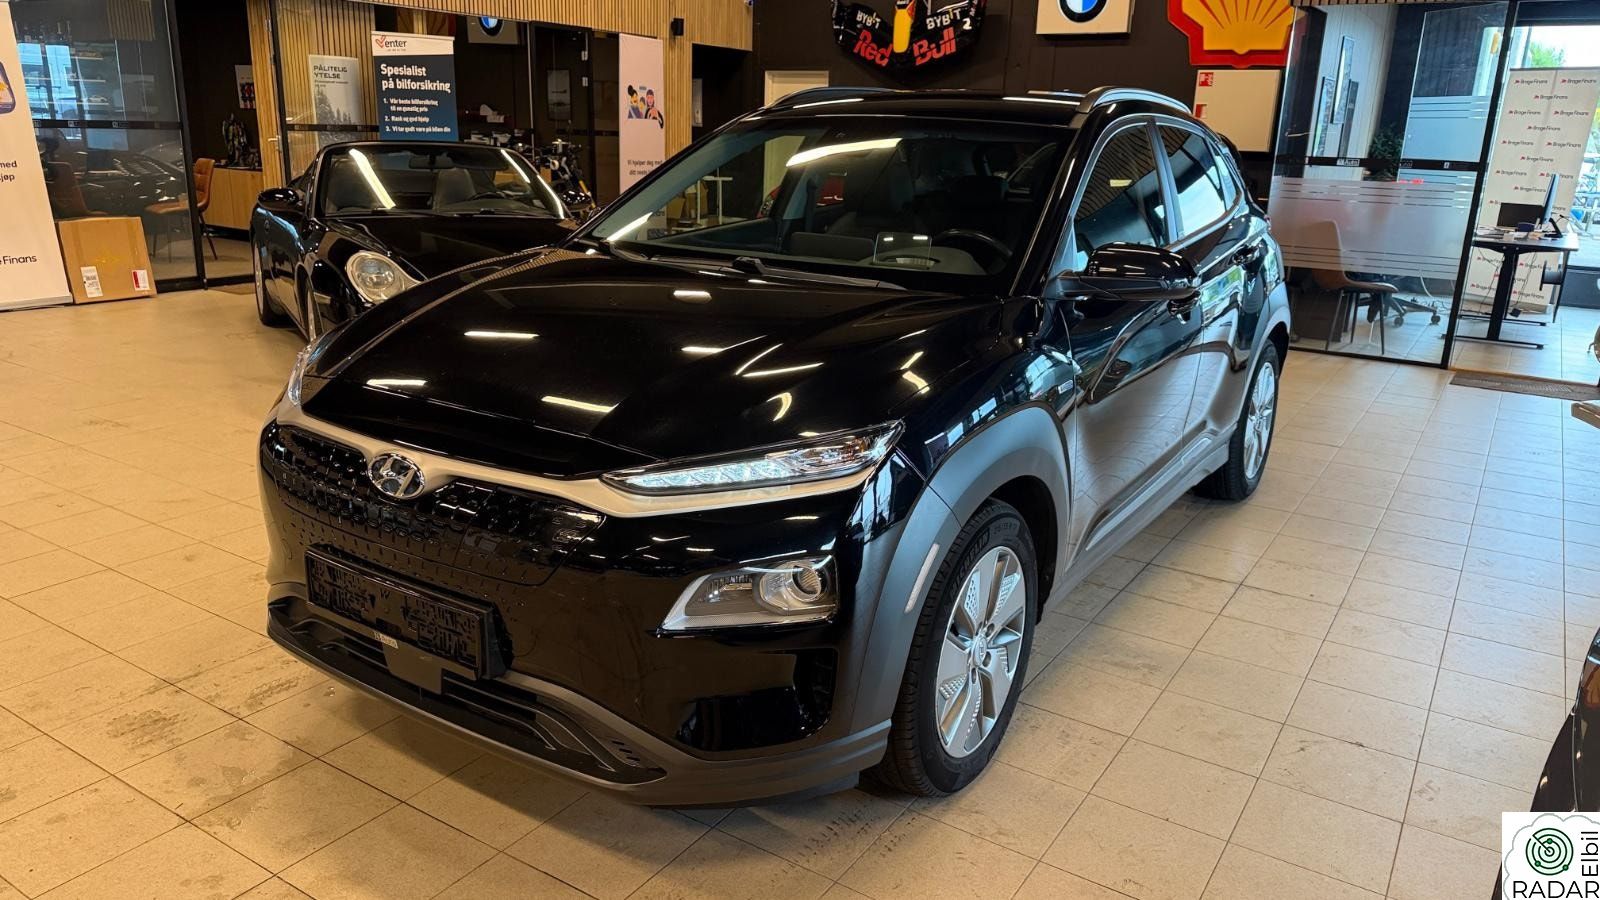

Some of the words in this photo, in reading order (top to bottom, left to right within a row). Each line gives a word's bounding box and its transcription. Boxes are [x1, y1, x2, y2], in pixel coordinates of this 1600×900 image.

[925, 8, 962, 30] BYBIT
[962, 18, 972, 30] 2
[853, 29, 894, 67] Red
[912, 26, 957, 66] Bull
[380, 63, 427, 77] Spesialist
[381, 78, 395, 91] på
[396, 79, 451, 94] bilforsikring
[0, 173, 16, 182] jøp
[2, 255, 38, 265] Finans
